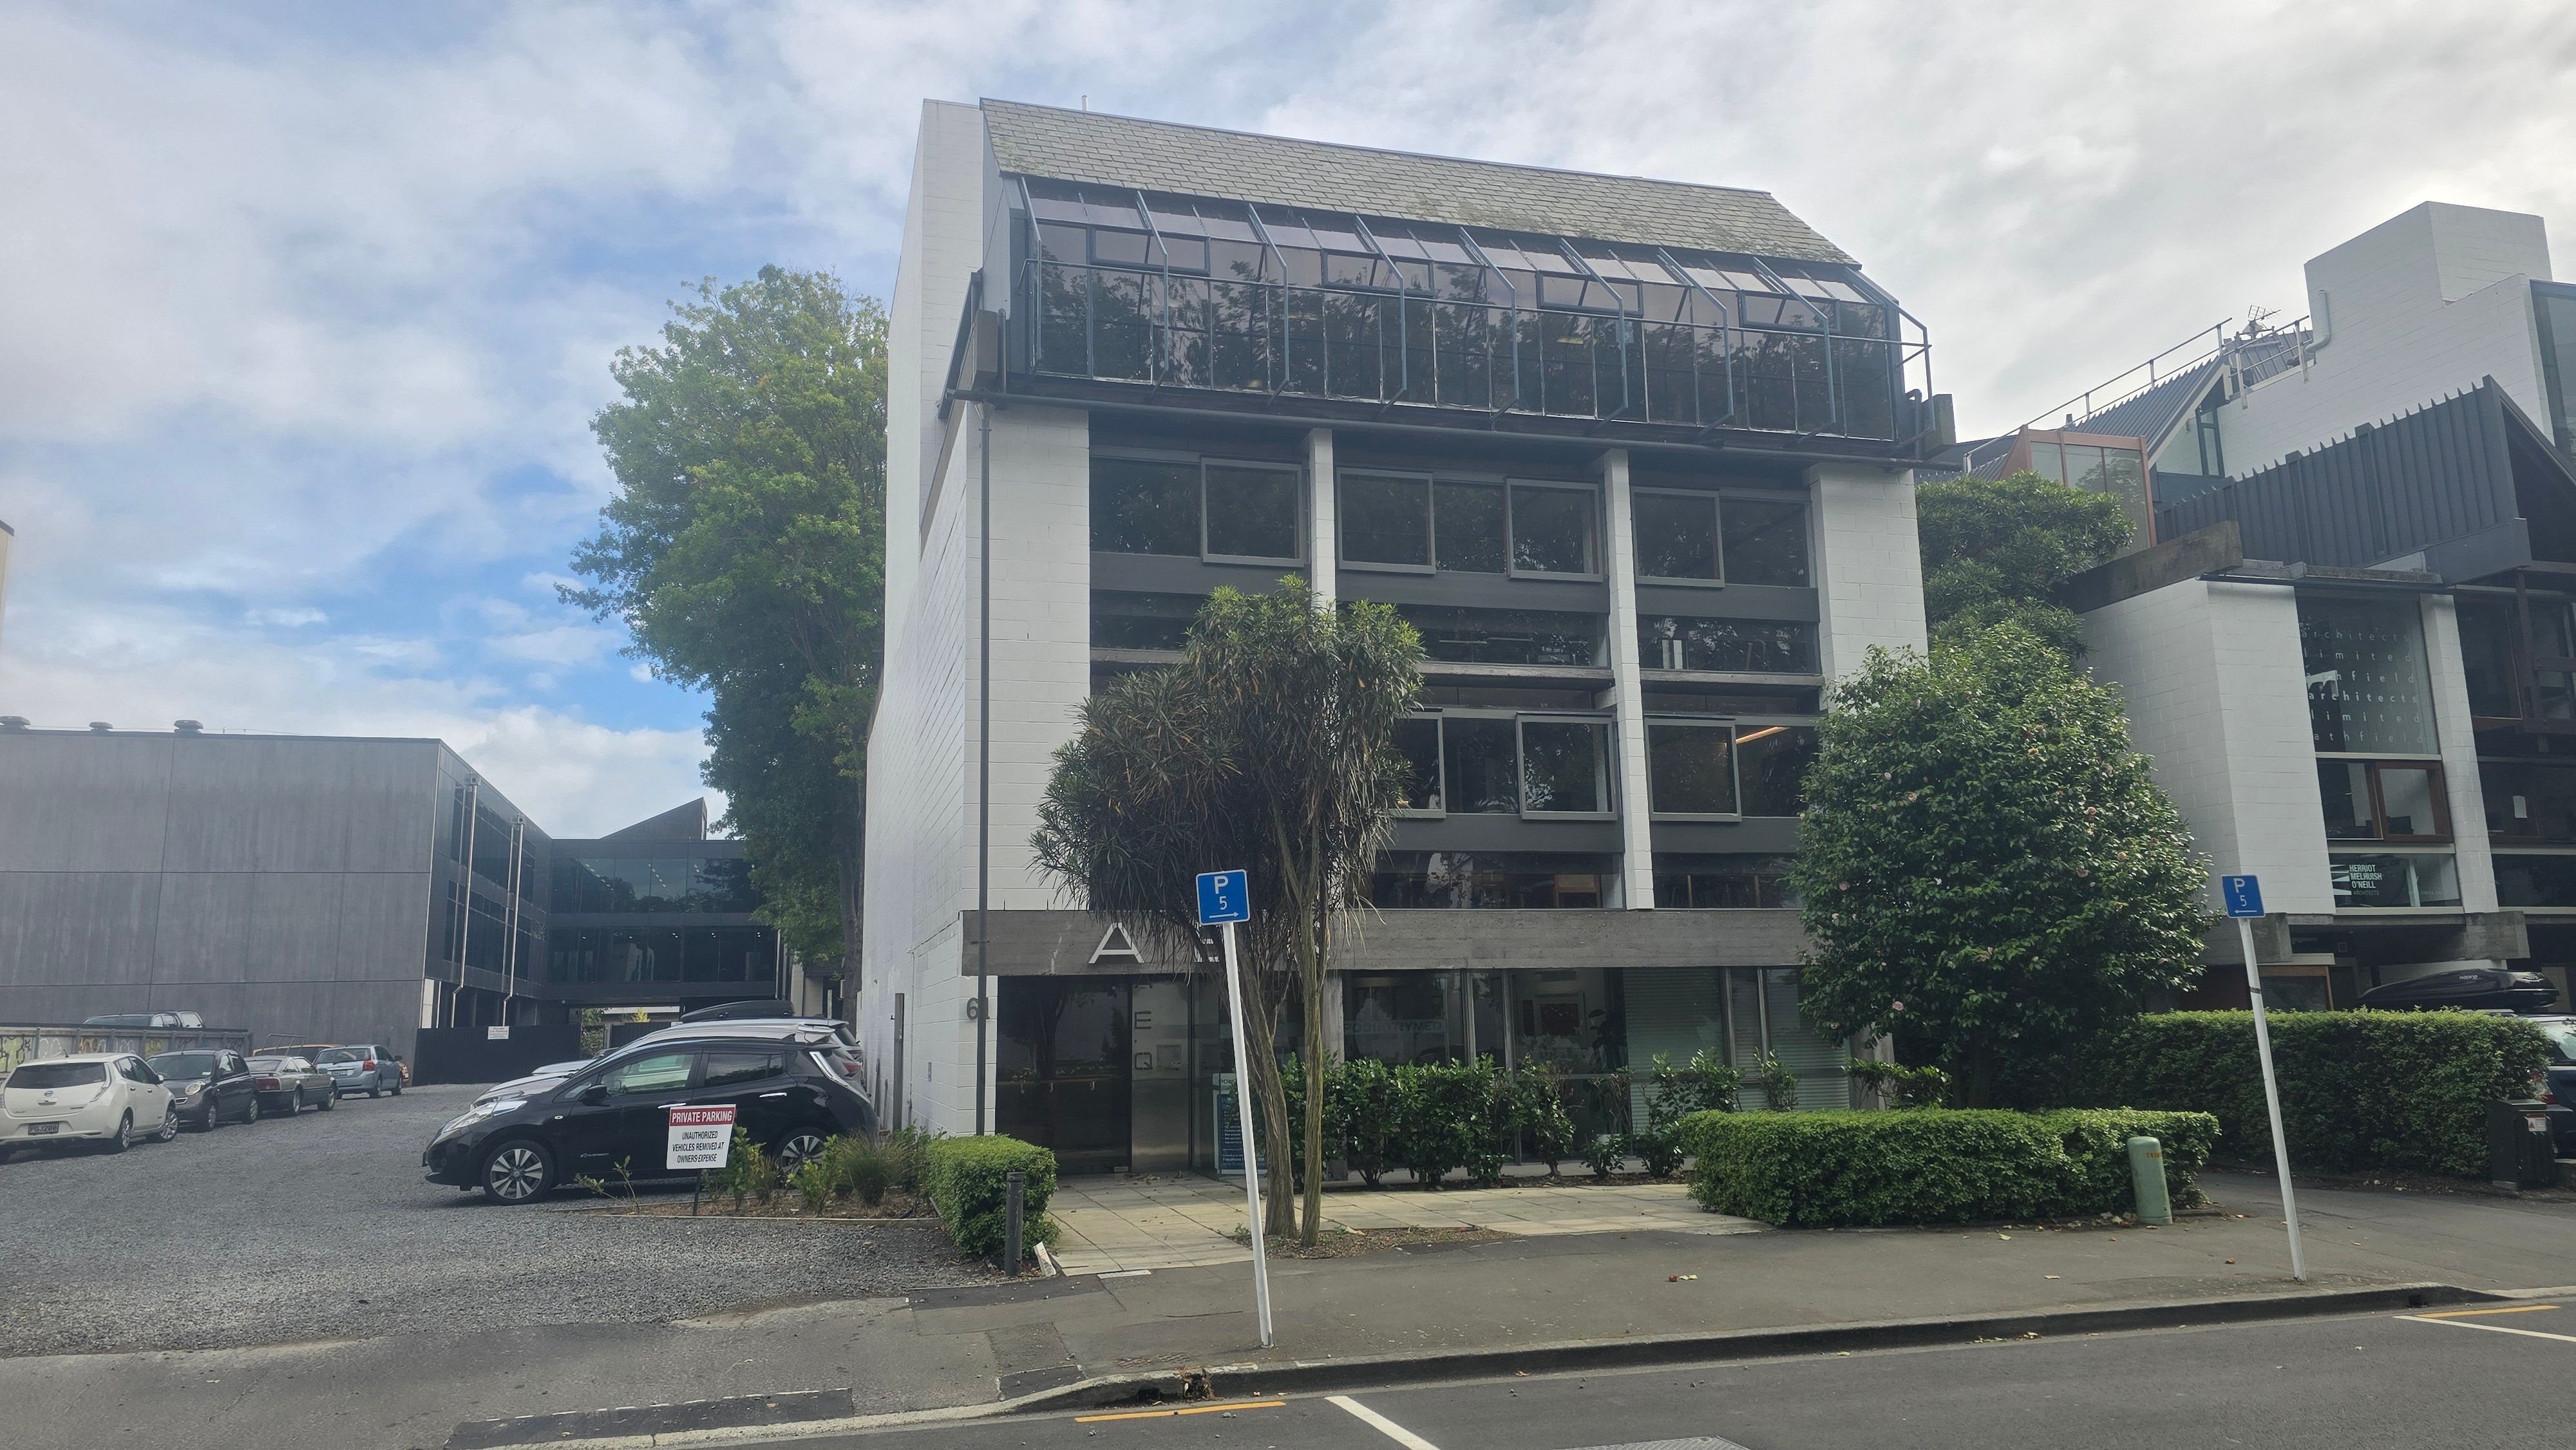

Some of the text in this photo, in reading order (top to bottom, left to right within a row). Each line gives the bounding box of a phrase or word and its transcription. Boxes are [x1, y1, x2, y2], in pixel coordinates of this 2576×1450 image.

[2302, 630, 2409, 643] architects
[2304, 648, 2411, 662] limited
[2309, 690, 2417, 703] architects
[2311, 710, 2420, 723] limited
[2314, 731, 2423, 744] athfield
[2349, 864, 2376, 872] HERRIOT
[2351, 872, 2383, 881] MELHUISH
[1214, 876, 1229, 894] P
[2233, 878, 2245, 894] P
[2352, 880, 2376, 889] O'NEILL
[1219, 896, 1227, 910] 5
[2240, 895, 2247, 907] 5
[672, 1111, 732, 1123] PRIVATE PARKING
[682, 1131, 718, 1140] UNAUTHORIZED
[672, 1143, 695, 1152] VEHICLES
[696, 1142, 717, 1151] REMOVED
[677, 1154, 717, 1163] OWNERS EXPENSE
